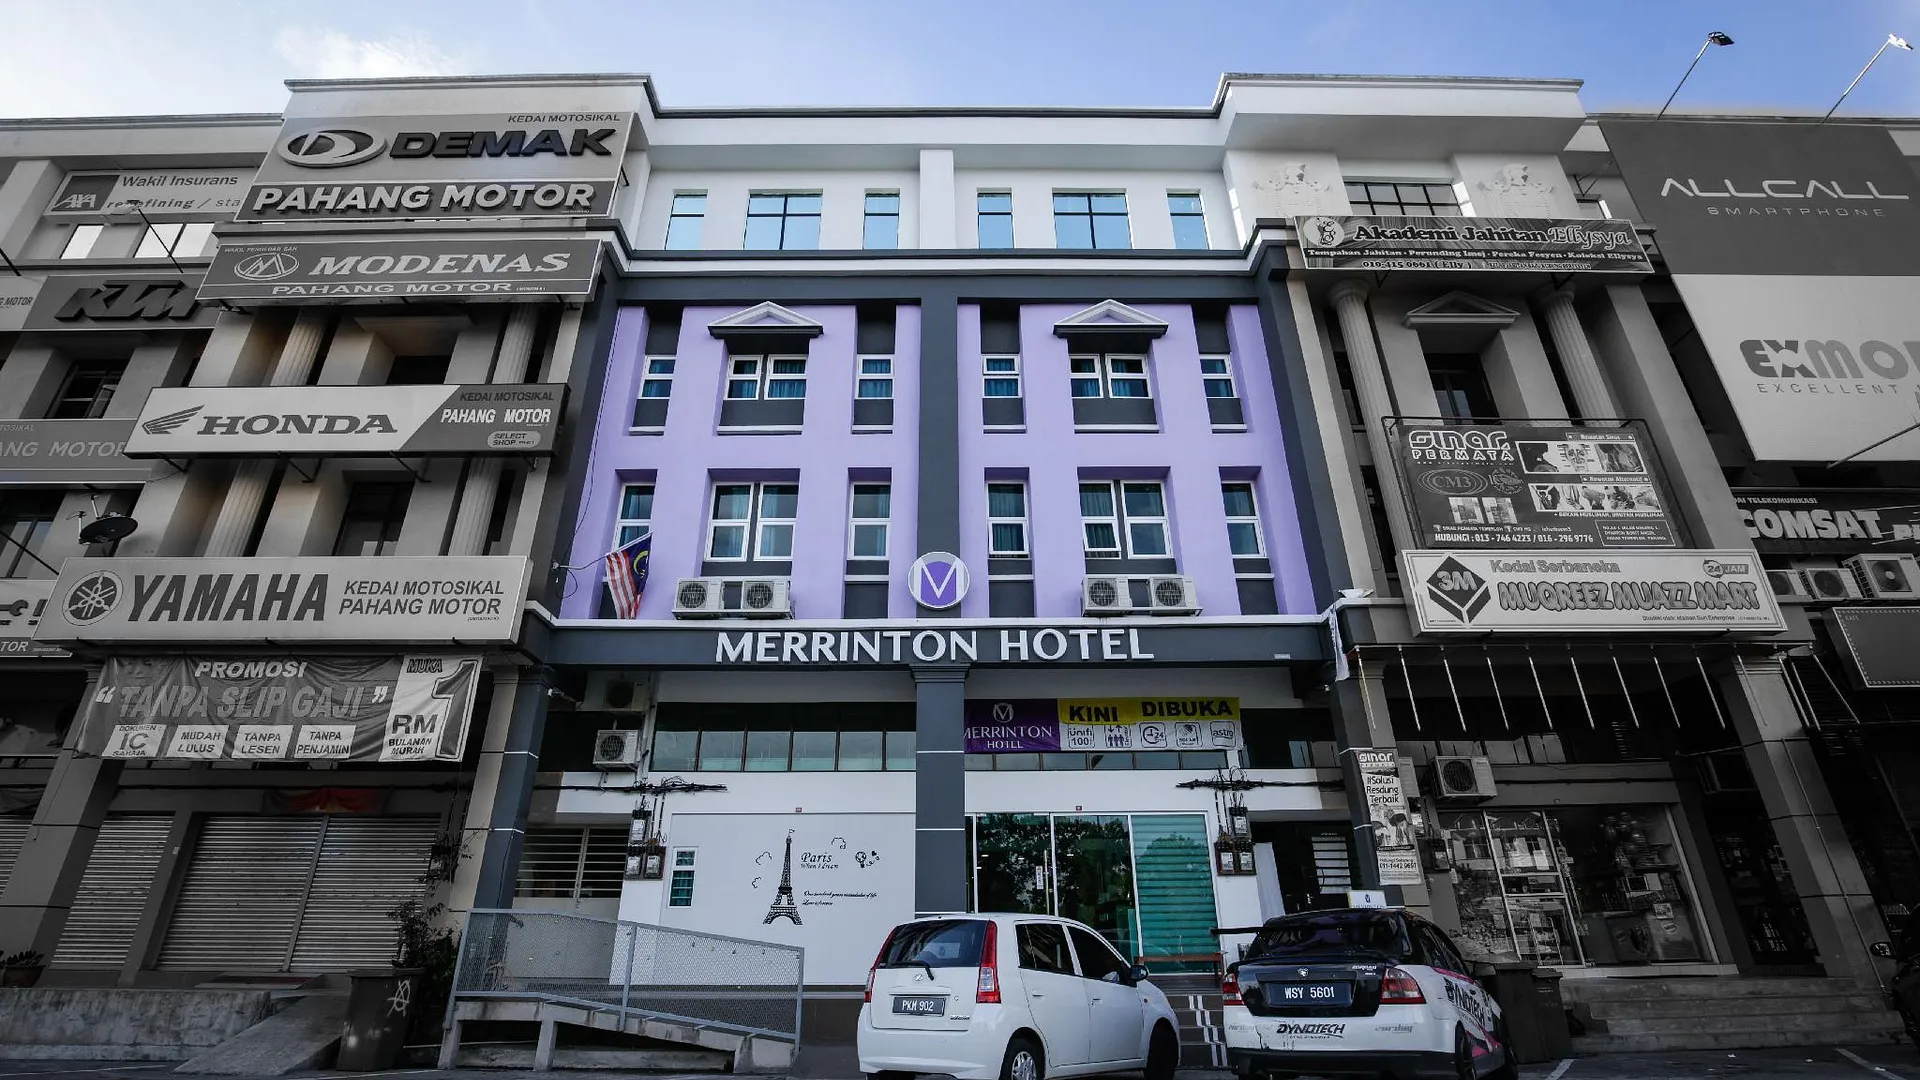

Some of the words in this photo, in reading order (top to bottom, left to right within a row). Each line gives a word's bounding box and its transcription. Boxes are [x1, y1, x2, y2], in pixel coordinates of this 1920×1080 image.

[508, 115, 546, 123] KEDAI
[548, 114, 620, 122] MOTOSIKAL
[389, 128, 616, 157] DEMAK
[121, 175, 167, 187] Wakil
[170, 175, 238, 186] Insurans
[54, 193, 97, 208] AXA
[253, 184, 431, 214] PAHANG
[440, 183, 597, 211] MOTOR
[1707, 206, 1885, 217] SMARTPHONE
[1354, 226, 1460, 241] Akademi
[1462, 227, 1549, 242] Jahitan
[1548, 225, 1633, 250] Ellysya
[1307, 249, 1361, 257] Tempahan
[308, 253, 571, 276] MODENAS
[272, 283, 395, 295] PAHANG
[406, 282, 512, 293] MOTOR
[55, 280, 201, 321] KTM
[1757, 383, 1899, 394] EXCELLENT
[460, 392, 492, 401] KEDAI
[495, 392, 555, 401] MOTOSIKAL
[441, 409, 496, 423] PAHANG
[503, 409, 551, 423] MOTOR
[197, 414, 398, 435] HONDA
[1411, 450, 1515, 461] PERMATA
[1475, 534, 1489, 542] 013
[1496, 534, 1511, 542] 746
[1512, 534, 1531, 542] 4223
[1537, 534, 1552, 542] 016
[1490, 560, 1537, 572] Kedai
[1538, 560, 1621, 573] Serbaneka
[1724, 566, 1746, 574] JAM
[1437, 571, 1477, 591] 3M
[344, 581, 399, 595] KEDAI
[402, 580, 504, 595] MOTOSIKAL
[127, 573, 329, 622] YAMAHA
[1497, 581, 1614, 612] MUQREEZ
[1611, 581, 1698, 611] MUAZZ
[1694, 581, 1760, 610] MART
[338, 598, 424, 615] PAHANG
[428, 598, 502, 615] MOTOR
[715, 630, 978, 664] MERRINTON
[1000, 628, 1155, 662] HOTEL
[195, 661, 308, 678] PROMOSI
[407, 658, 443, 673] MUKA
[217, 686, 287, 718] SLIP
[431, 659, 479, 759] 1
[1069, 705, 1119, 722] KINI
[1141, 700, 1233, 717] DIBUKA
[392, 714, 438, 734] RM
[181, 732, 221, 741] MUDAH
[244, 733, 281, 742] TANPA
[309, 731, 342, 741] TANPA
[1212, 729, 1234, 738] astro
[120, 733, 149, 750] IC
[389, 737, 431, 747] BULANAN
[177, 744, 215, 753] LULUS
[241, 745, 280, 754] LESEN
[297, 744, 349, 754] PENJAMIN
[391, 746, 425, 755] MURAH
[1367, 775, 1394, 785] #Solusi
[1366, 786, 1399, 796] Resdung
[1370, 794, 1399, 803] Terbaik
[801, 852, 832, 862] Paris
[1284, 987, 1305, 999] WSY
[1310, 986, 1335, 998] 5601
[902, 1000, 918, 1011] PKM
[919, 1000, 934, 1011] 902
[1276, 1023, 1346, 1035] DYNOTECH
